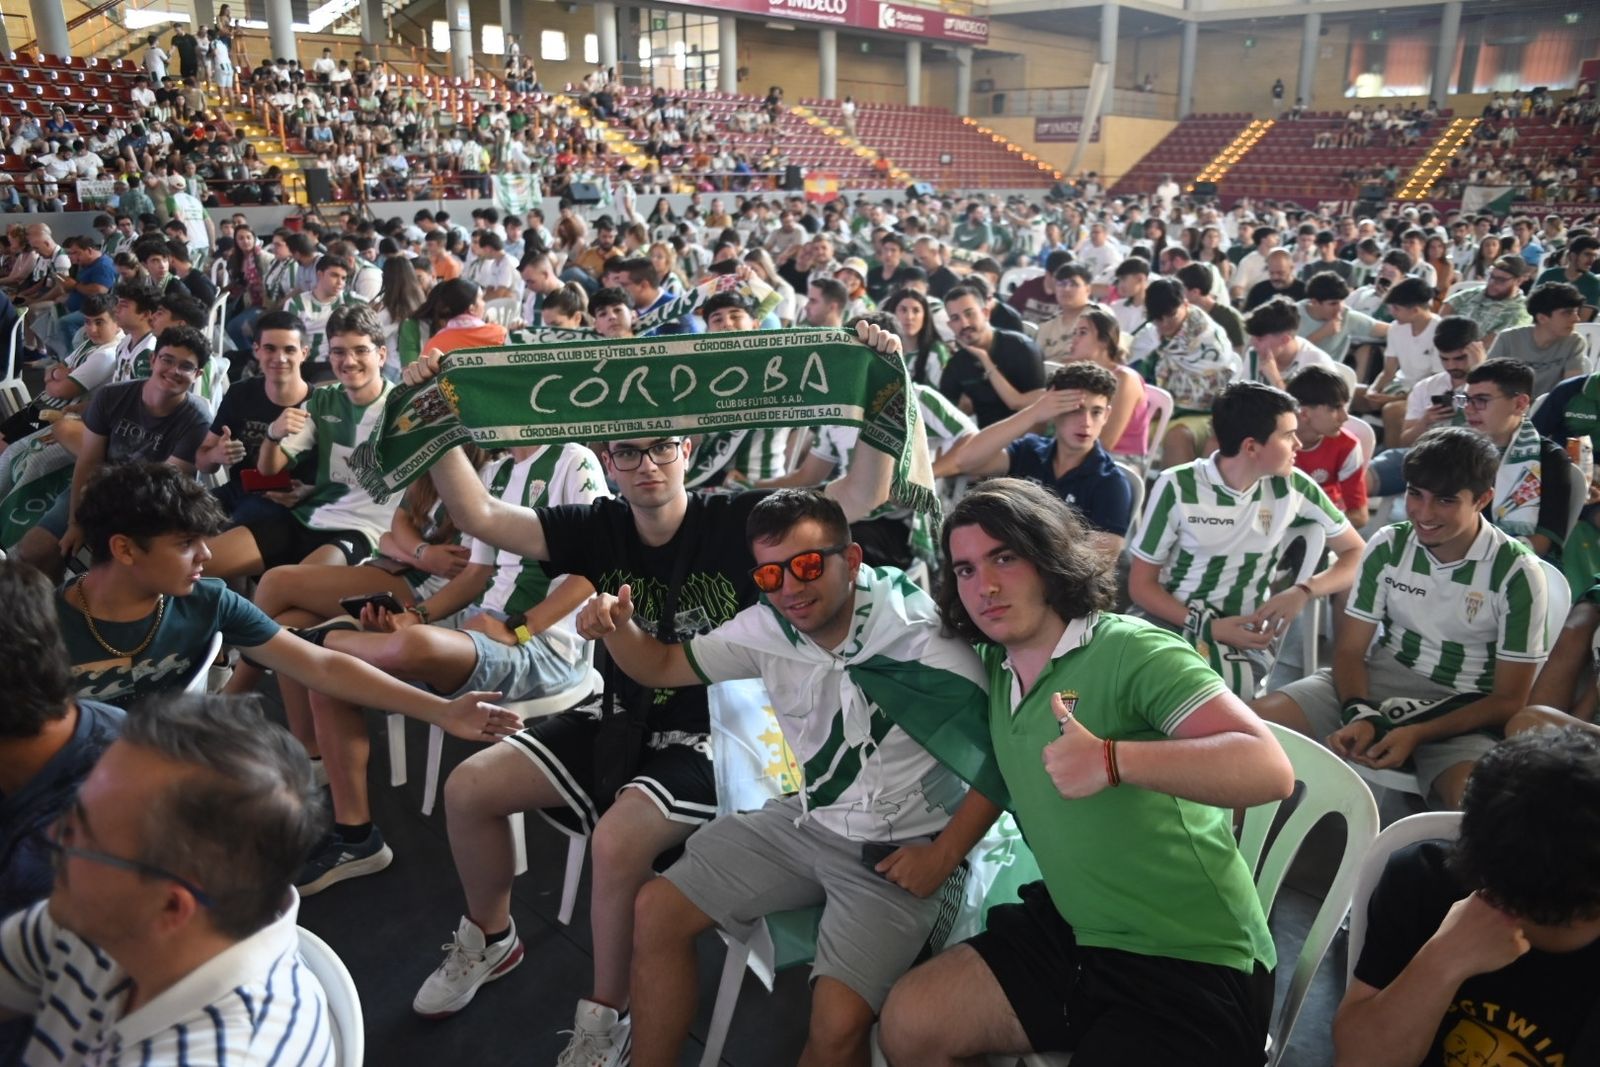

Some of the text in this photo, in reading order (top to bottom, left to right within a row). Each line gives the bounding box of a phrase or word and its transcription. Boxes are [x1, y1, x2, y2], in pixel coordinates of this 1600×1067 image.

[693, 332, 852, 352] CÓRDOBA CLUB DE FÚTBOL S.A.D.
[458, 355, 487, 367] S.A.D.
[507, 345, 668, 364] CÓRDOBA CLUB DE FÚTBOL S.A.D.
[530, 351, 830, 414] CÓRDOBA
[716, 398, 737, 409] CLUB
[738, 398, 747, 408] DE
[782, 394, 804, 403] S.A.D.
[697, 407, 843, 426] CÓRDOBA CLUB DE FÚTBOL S.A.D.
[473, 430, 499, 440] S.A.D.
[520, 419, 674, 438] CÓRDOBA CLUB DE FÚTBOL S.A.D.
[393, 451, 430, 482] CÓRDOBA
[427, 436, 448, 454] CLUB
[446, 429, 459, 441] DE
[1188, 516, 1234, 526] GIVOVA
[1385, 577, 1426, 597] GVOVA
